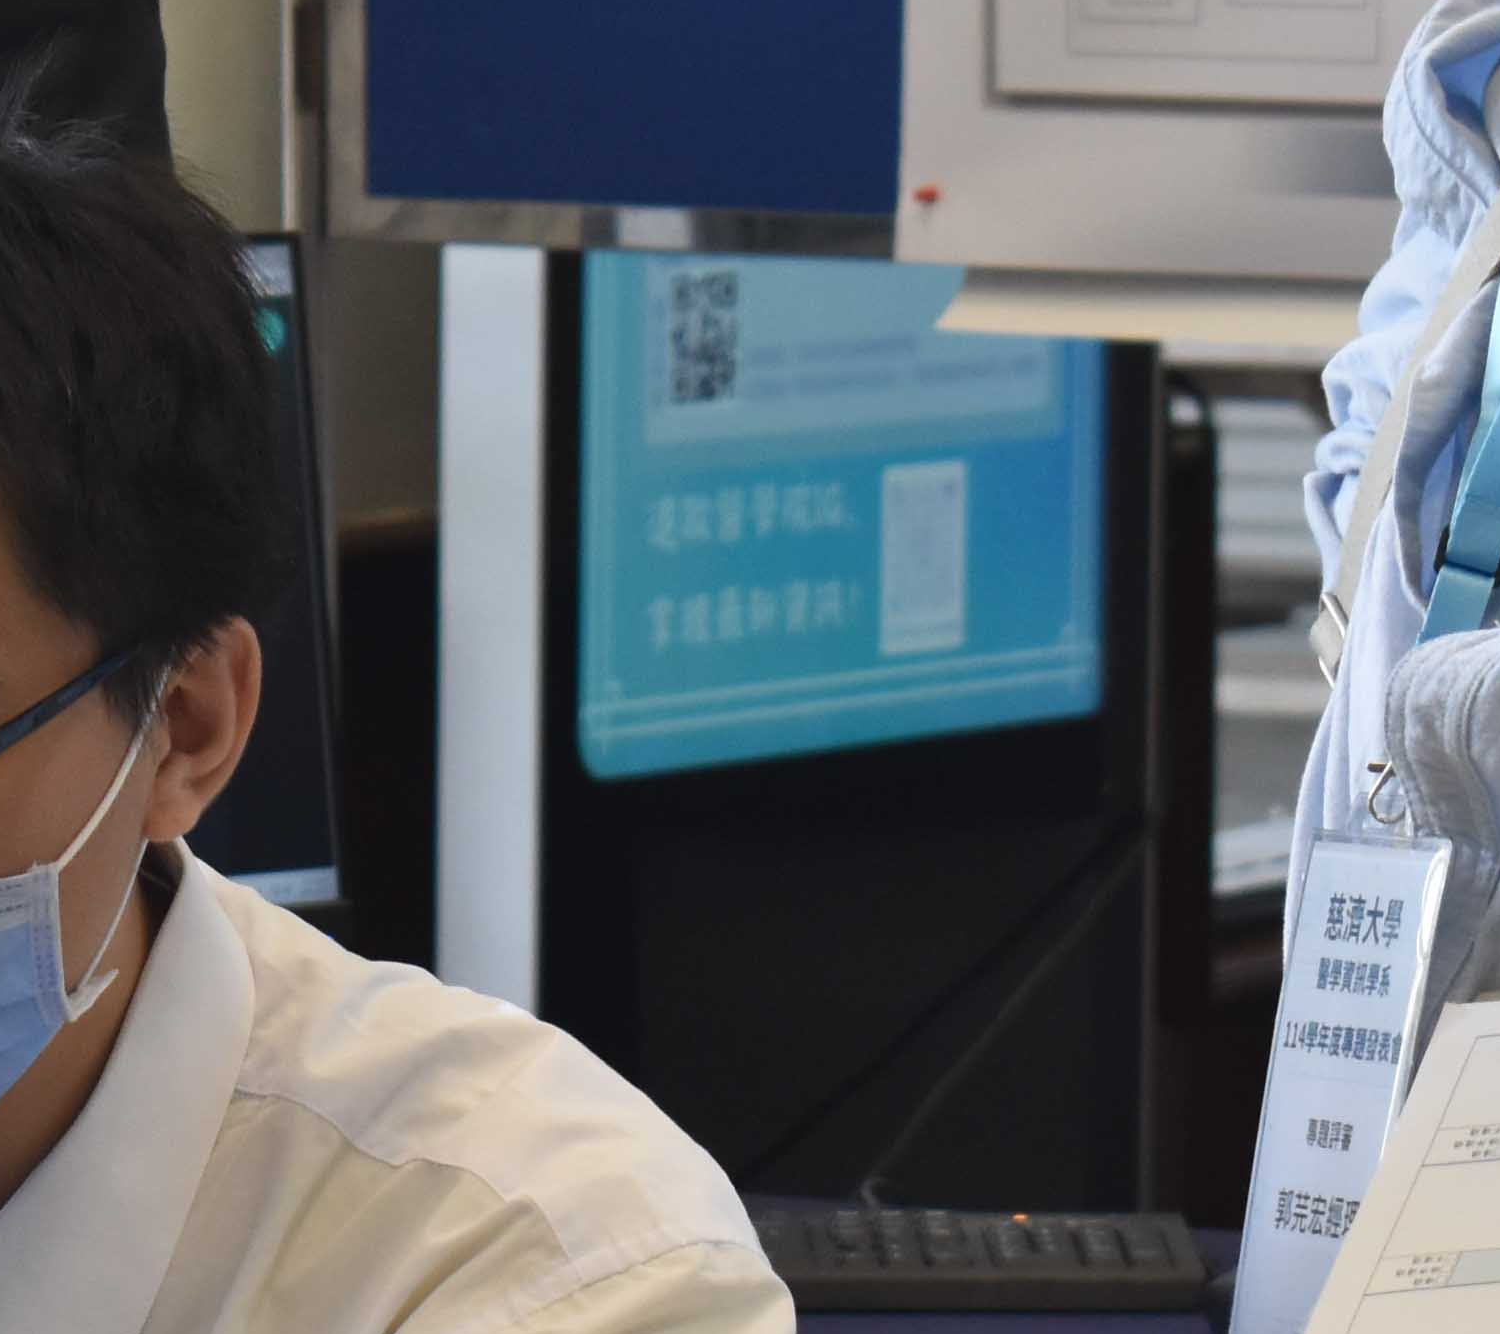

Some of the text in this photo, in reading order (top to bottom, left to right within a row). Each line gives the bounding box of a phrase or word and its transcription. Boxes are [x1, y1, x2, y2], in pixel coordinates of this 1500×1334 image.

[1324, 891, 1405, 948] 慈濟大學
[1315, 956, 1393, 999] 醫學資訊學系
